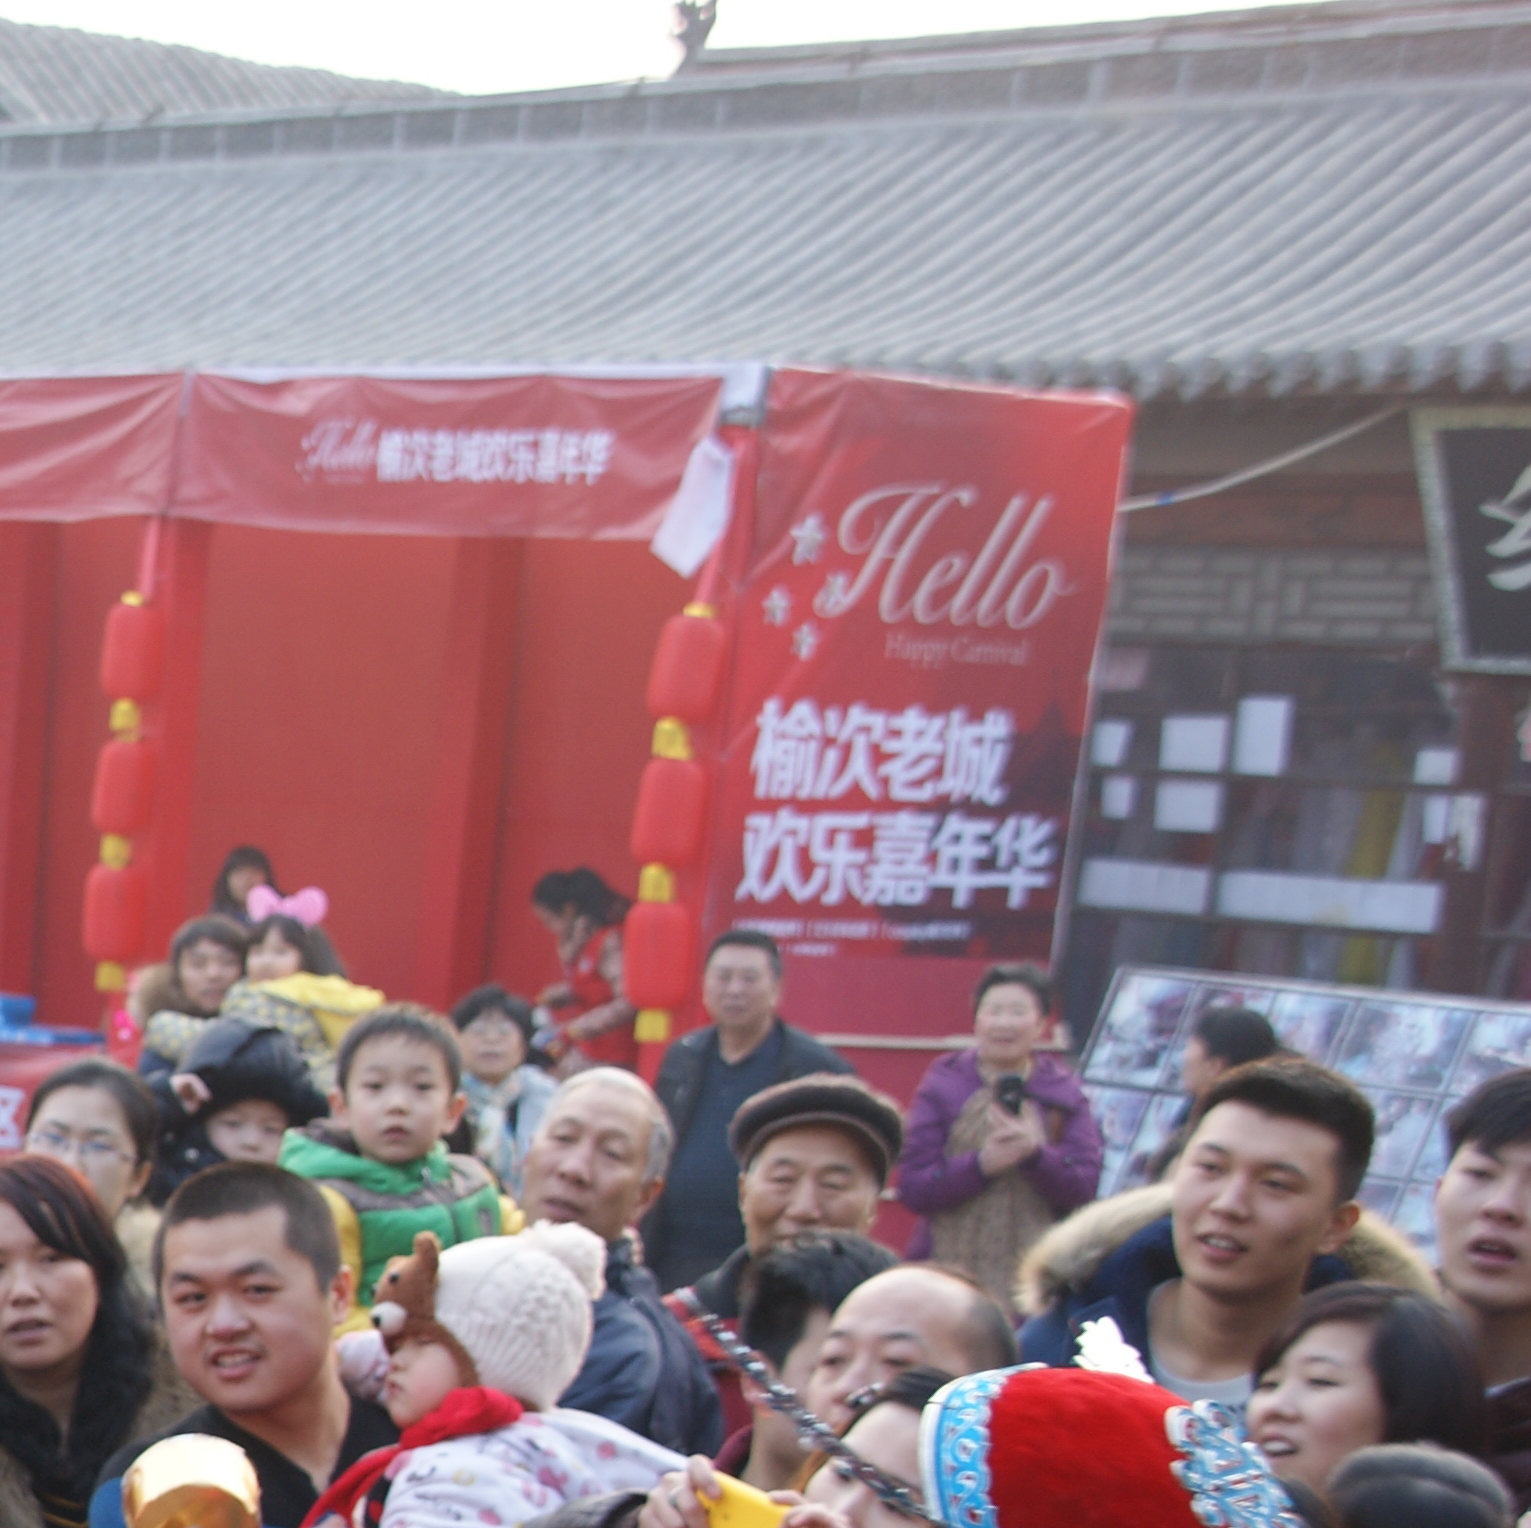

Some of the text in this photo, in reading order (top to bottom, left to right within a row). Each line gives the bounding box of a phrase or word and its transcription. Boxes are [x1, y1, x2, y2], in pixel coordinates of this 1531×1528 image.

[812, 481, 1075, 630] Hello
[885, 632, 1031, 668] Happy Carnival
[750, 698, 1015, 806] 榆次老城
[735, 806, 1057, 909] 欢乐嘉年华
